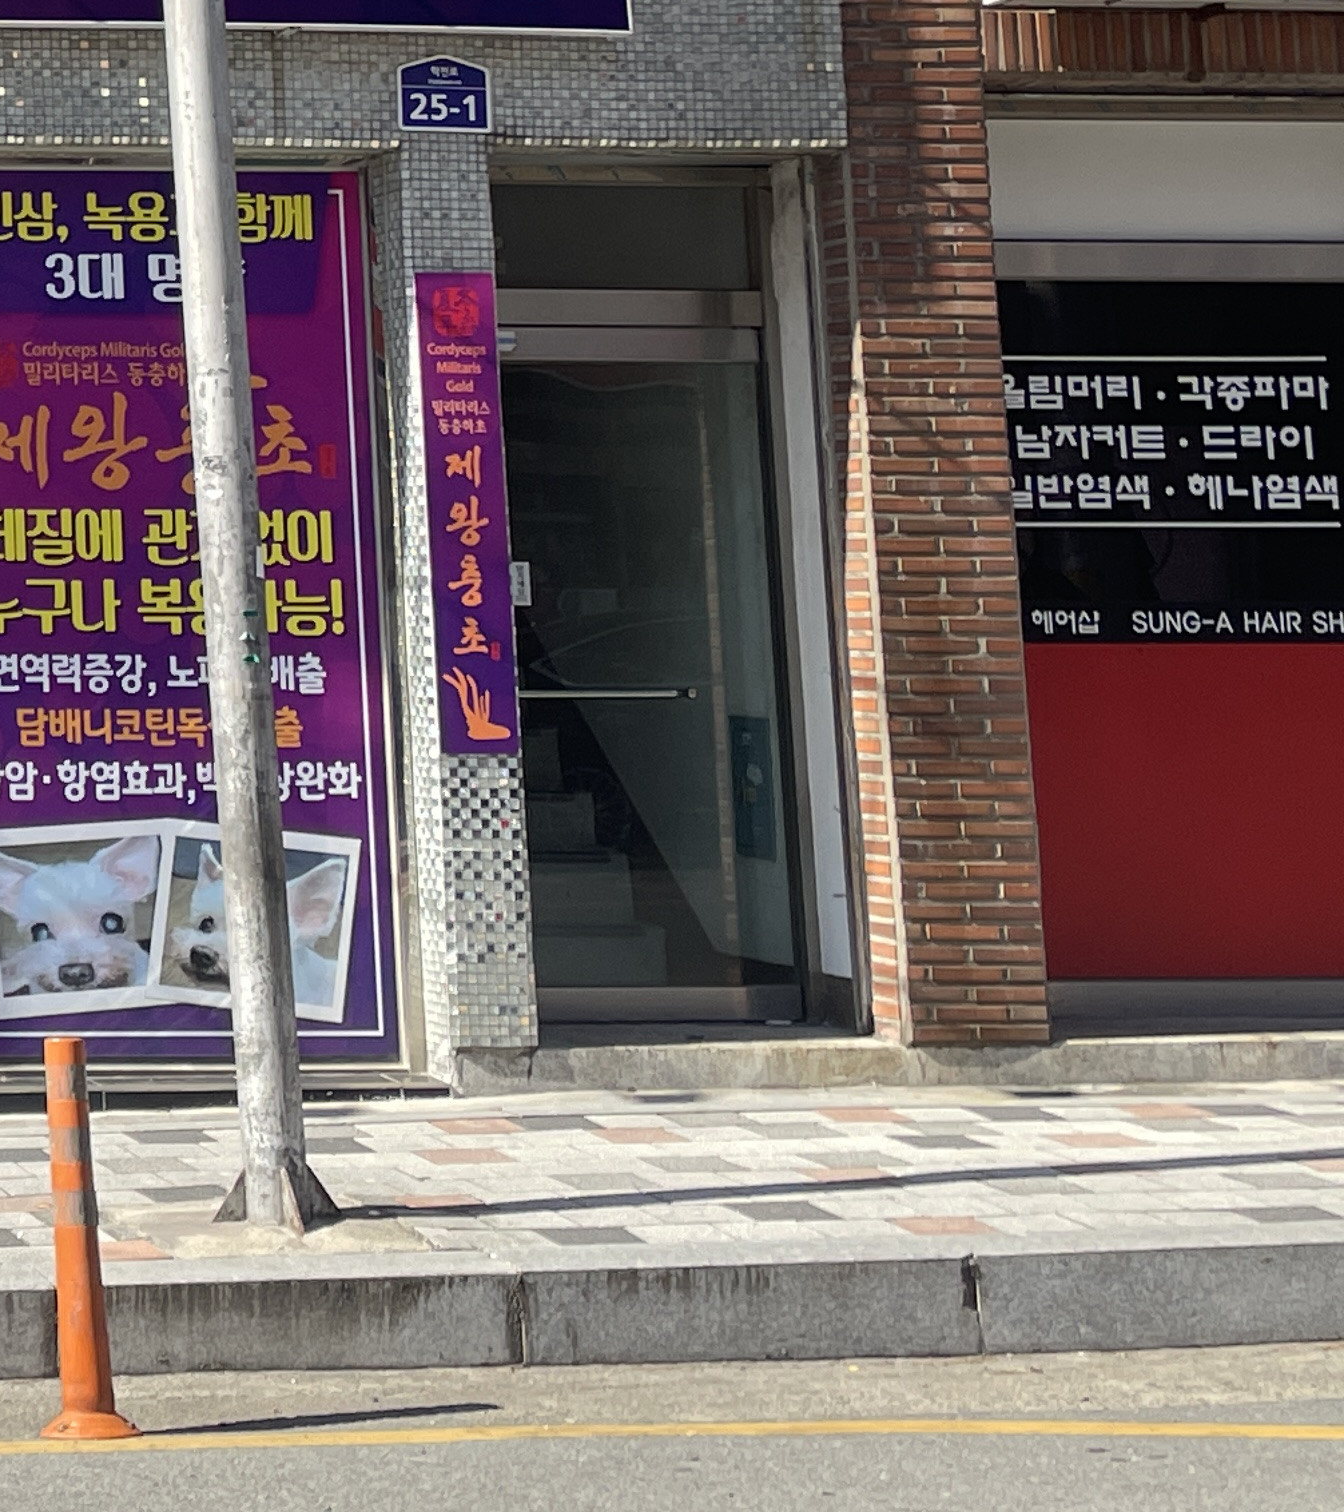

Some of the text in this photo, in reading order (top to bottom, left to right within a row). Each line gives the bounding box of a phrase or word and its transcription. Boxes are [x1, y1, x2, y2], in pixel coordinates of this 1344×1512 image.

[409, 92, 477, 122] 25-1
[83, 191, 179, 242] 녹용
[44, 253, 125, 300] 3대
[22, 340, 185, 361] Cordyceps Militaris Gol
[426, 343, 486, 358] Cordyceps
[23, 361, 120, 387] 밀리타리스
[126, 361, 186, 387] 동충하
[436, 361, 482, 375] Militaris
[445, 379, 475, 393] Gold
[1177, 375, 1329, 411] 각종파마
[431, 399, 491, 417] 밀리타리스
[437, 418, 488, 435] 동충하초
[1015, 425, 1166, 460] 남자커트
[1203, 425, 1314, 460] 드라이
[1188, 473, 1339, 511] 헤나염색
[1132, 610, 1234, 634] SUNG-A
[1243, 610, 1303, 634] HAIR
